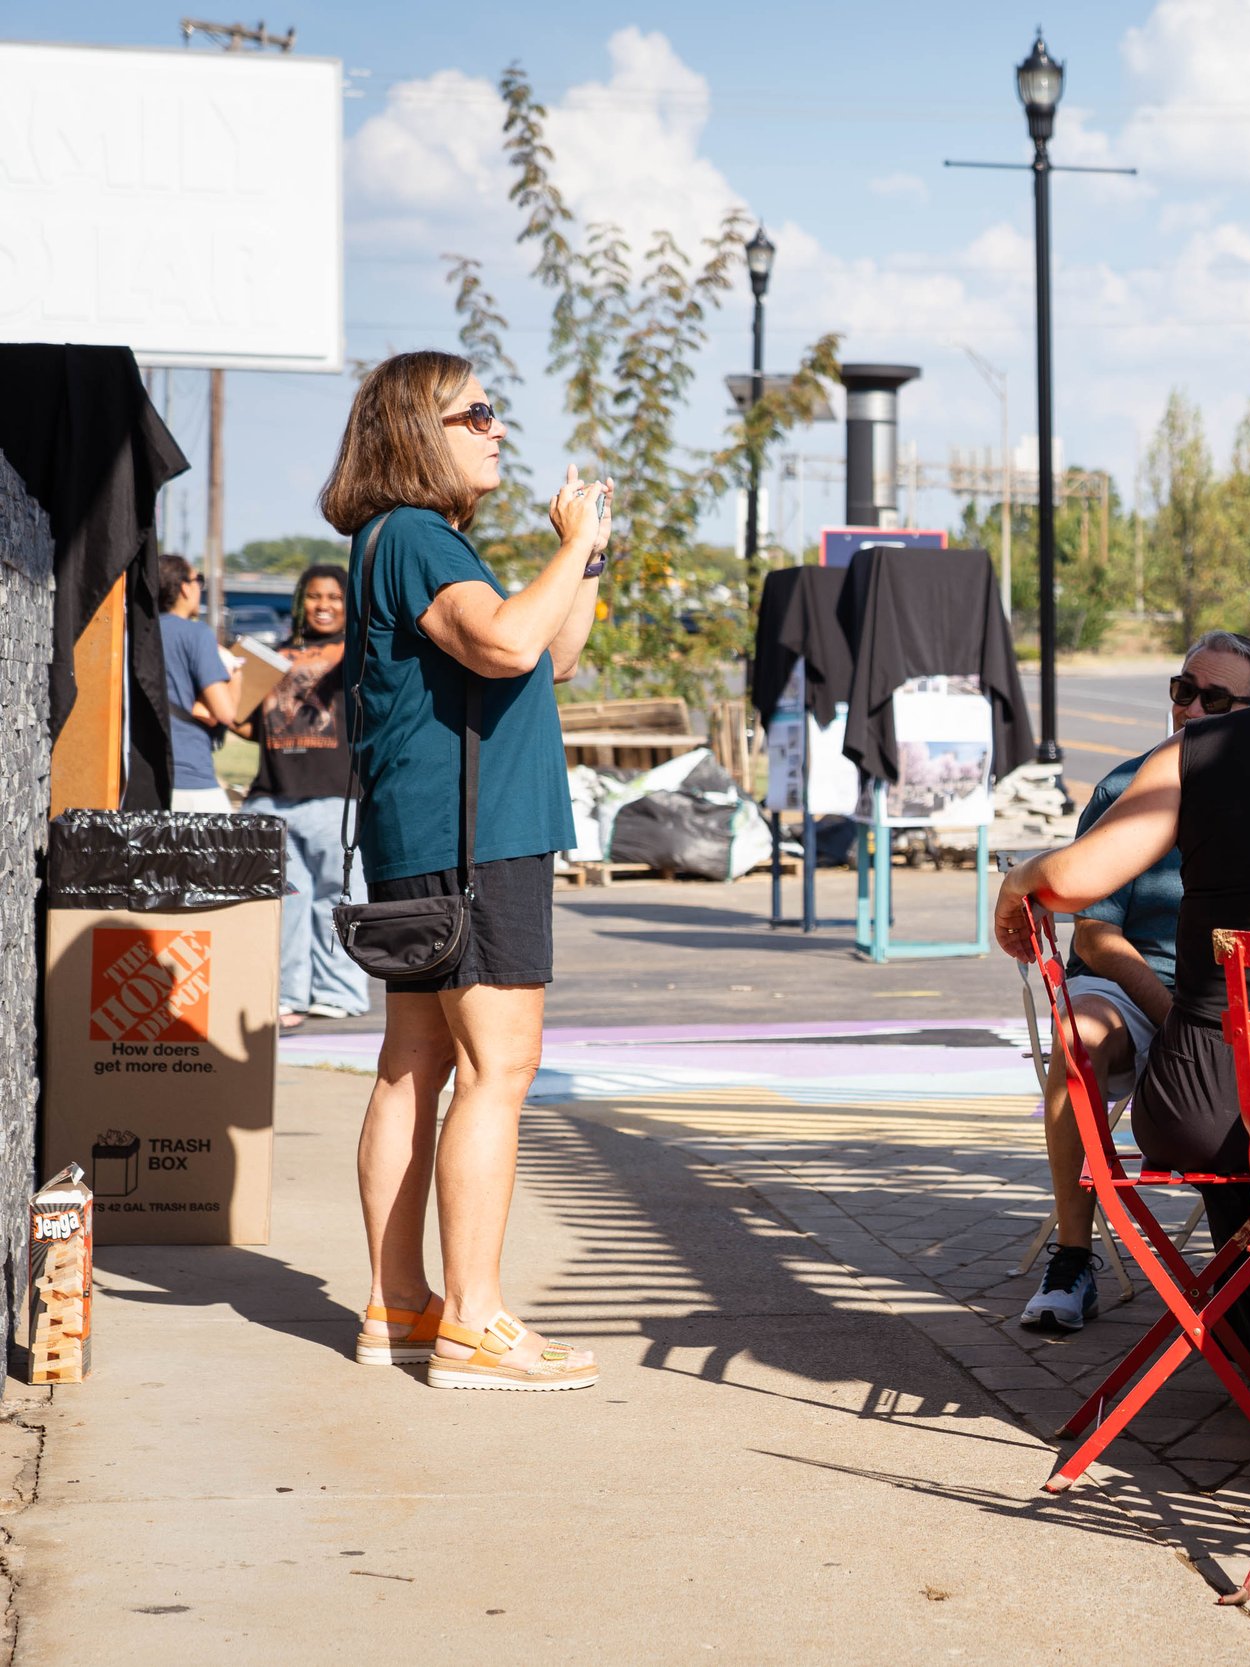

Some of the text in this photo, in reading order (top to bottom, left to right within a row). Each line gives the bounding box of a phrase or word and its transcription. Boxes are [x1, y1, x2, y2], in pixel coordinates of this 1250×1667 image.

[103, 941, 153, 985] THE
[92, 930, 211, 1040] HOME
[137, 971, 210, 1041] DEPOT
[112, 1042, 199, 1057] How doers
[94, 1060, 217, 1075] get more done.
[148, 1138, 211, 1153] TRASH
[148, 1156, 188, 1171] BOX
[108, 1202, 121, 1213] 42
[123, 1202, 146, 1213] GAL
[149, 1202, 186, 1213] TRASH
[189, 1202, 220, 1213] BAGS
[35, 1211, 80, 1240] Jenga
